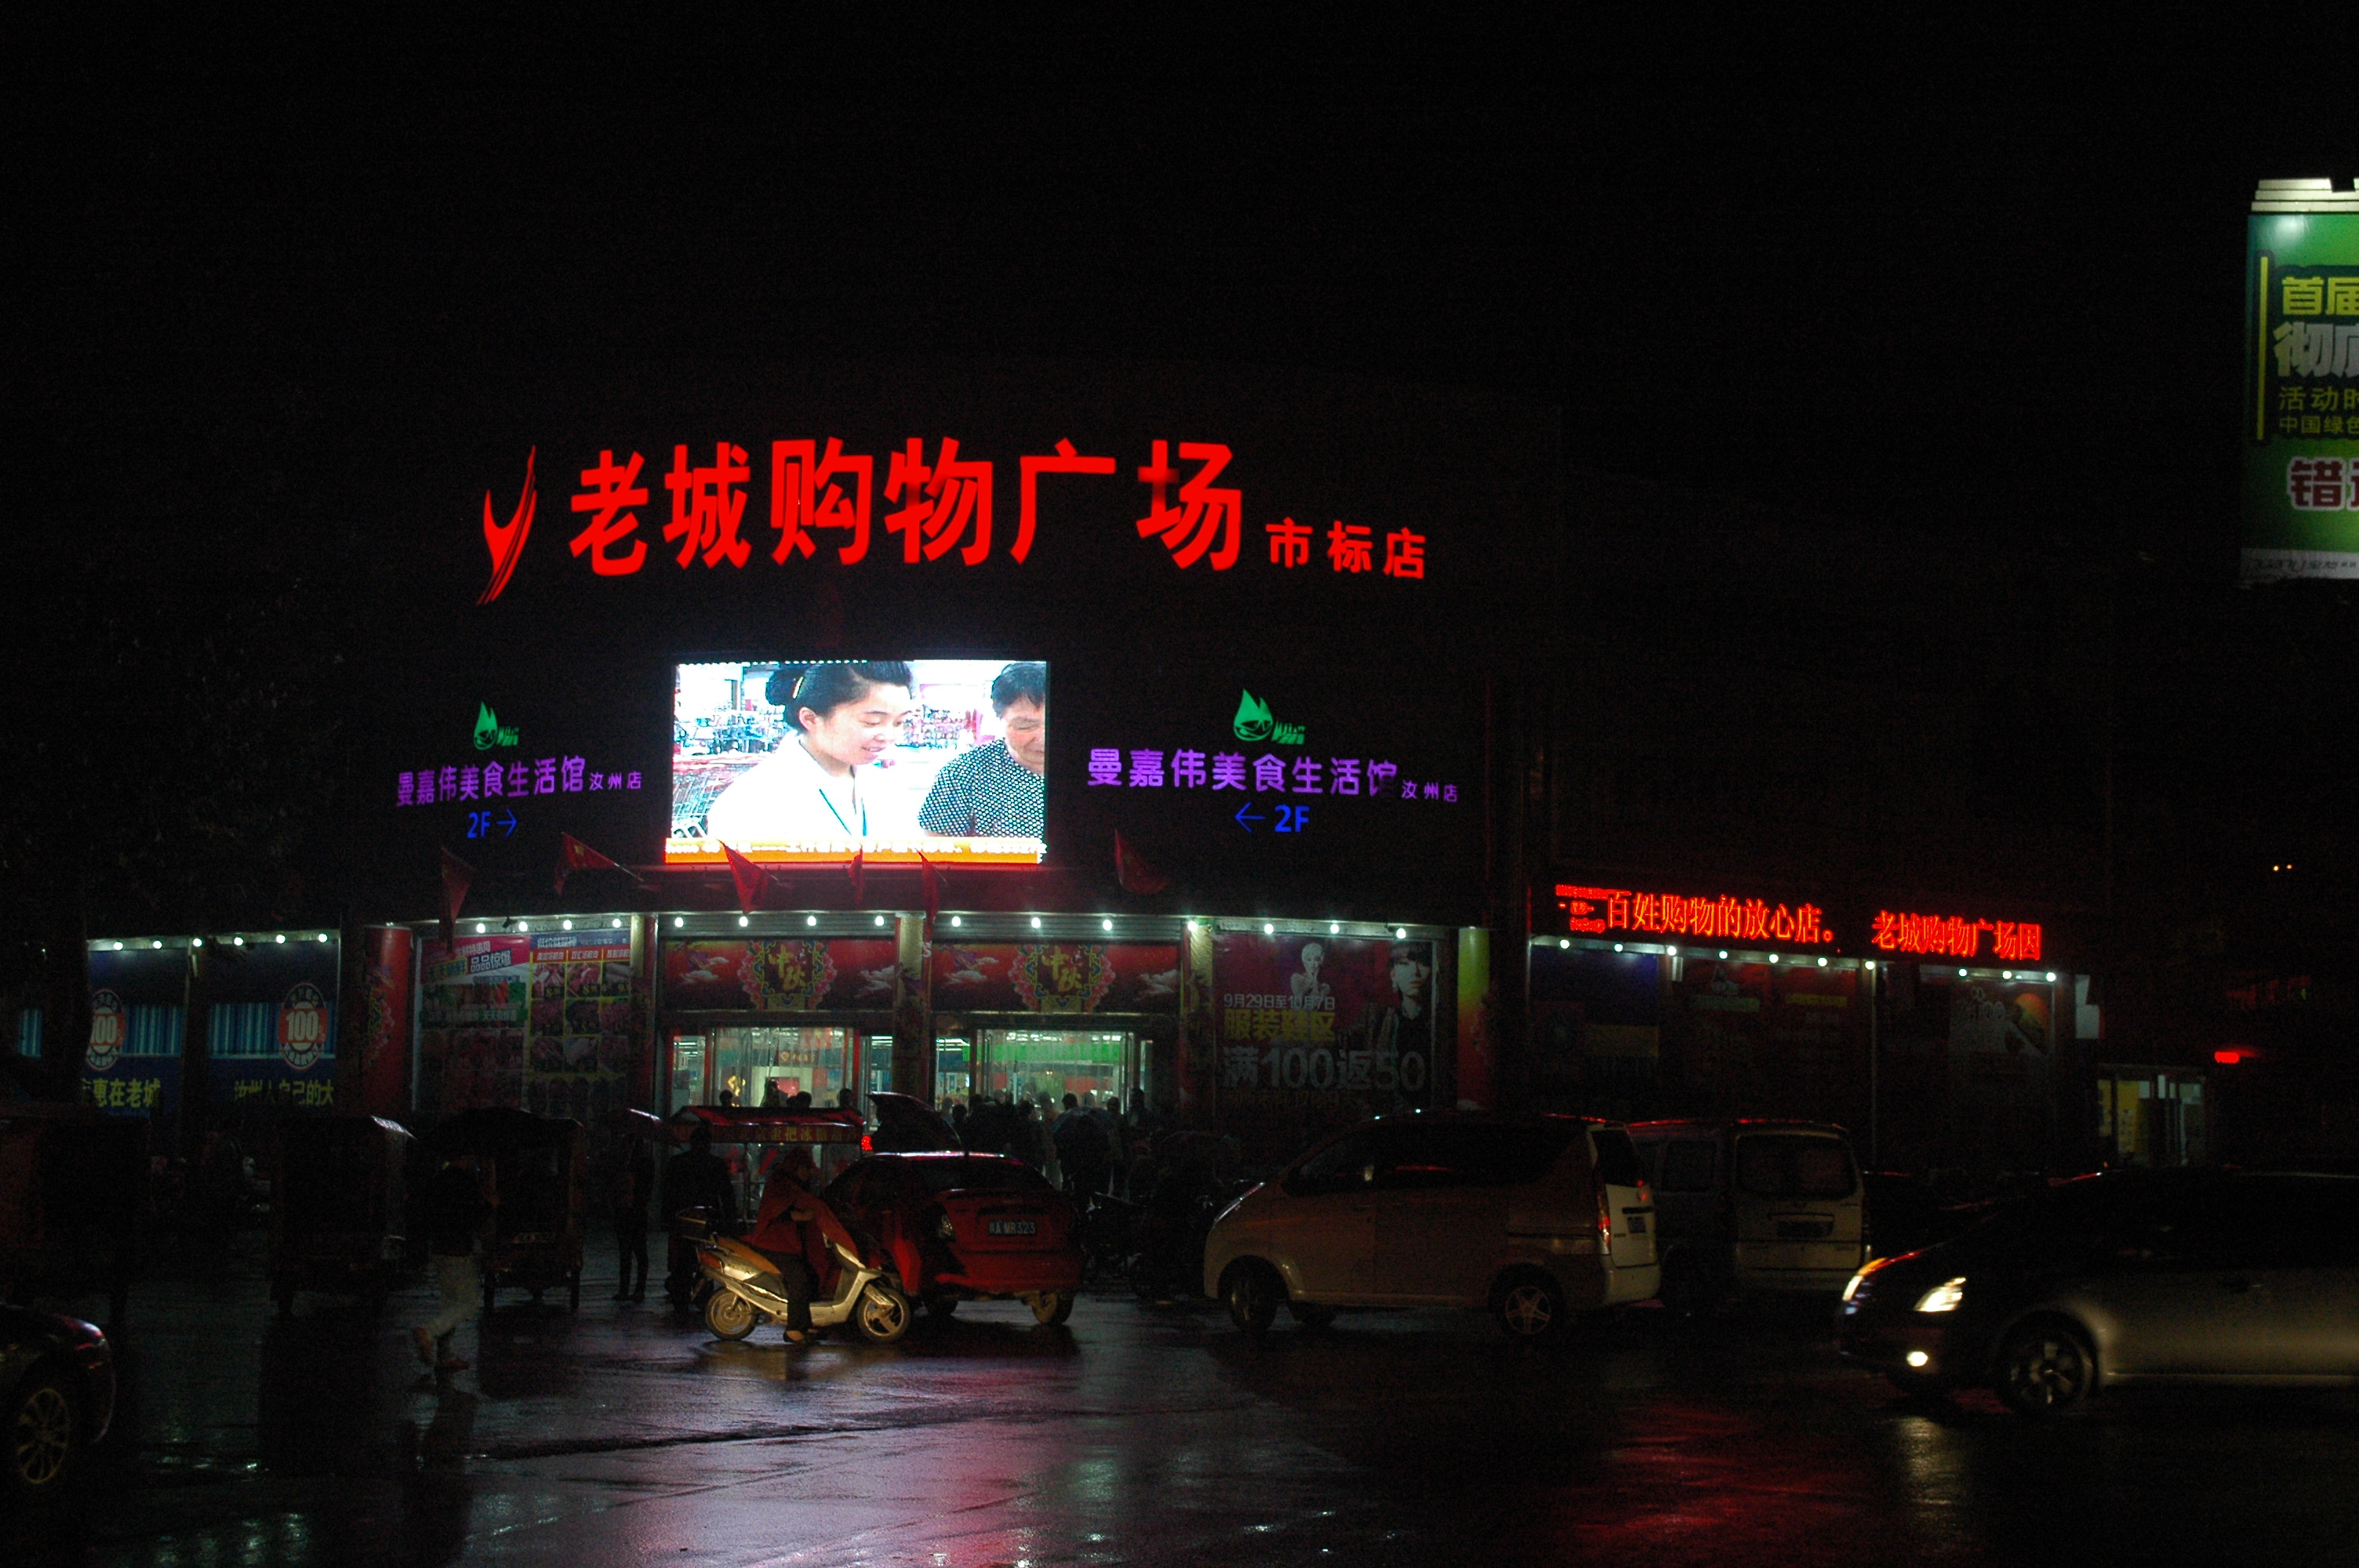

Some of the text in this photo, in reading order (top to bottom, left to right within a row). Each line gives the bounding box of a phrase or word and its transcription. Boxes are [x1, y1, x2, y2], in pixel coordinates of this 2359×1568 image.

[569, 436, 1426, 579] 老城购物广场 市标店
[396, 755, 642, 806] 曼嘉伟美食生活馆 汝州店
[1087, 748, 1458, 802] 曼嘉伟美食生活馆 汝州店
[467, 811, 493, 839] 2F
[1274, 804, 1310, 833] 2F
[1606, 891, 1834, 943] 百姓购物的放心店。
[1223, 993, 1336, 1010] 9月29日至10月7日
